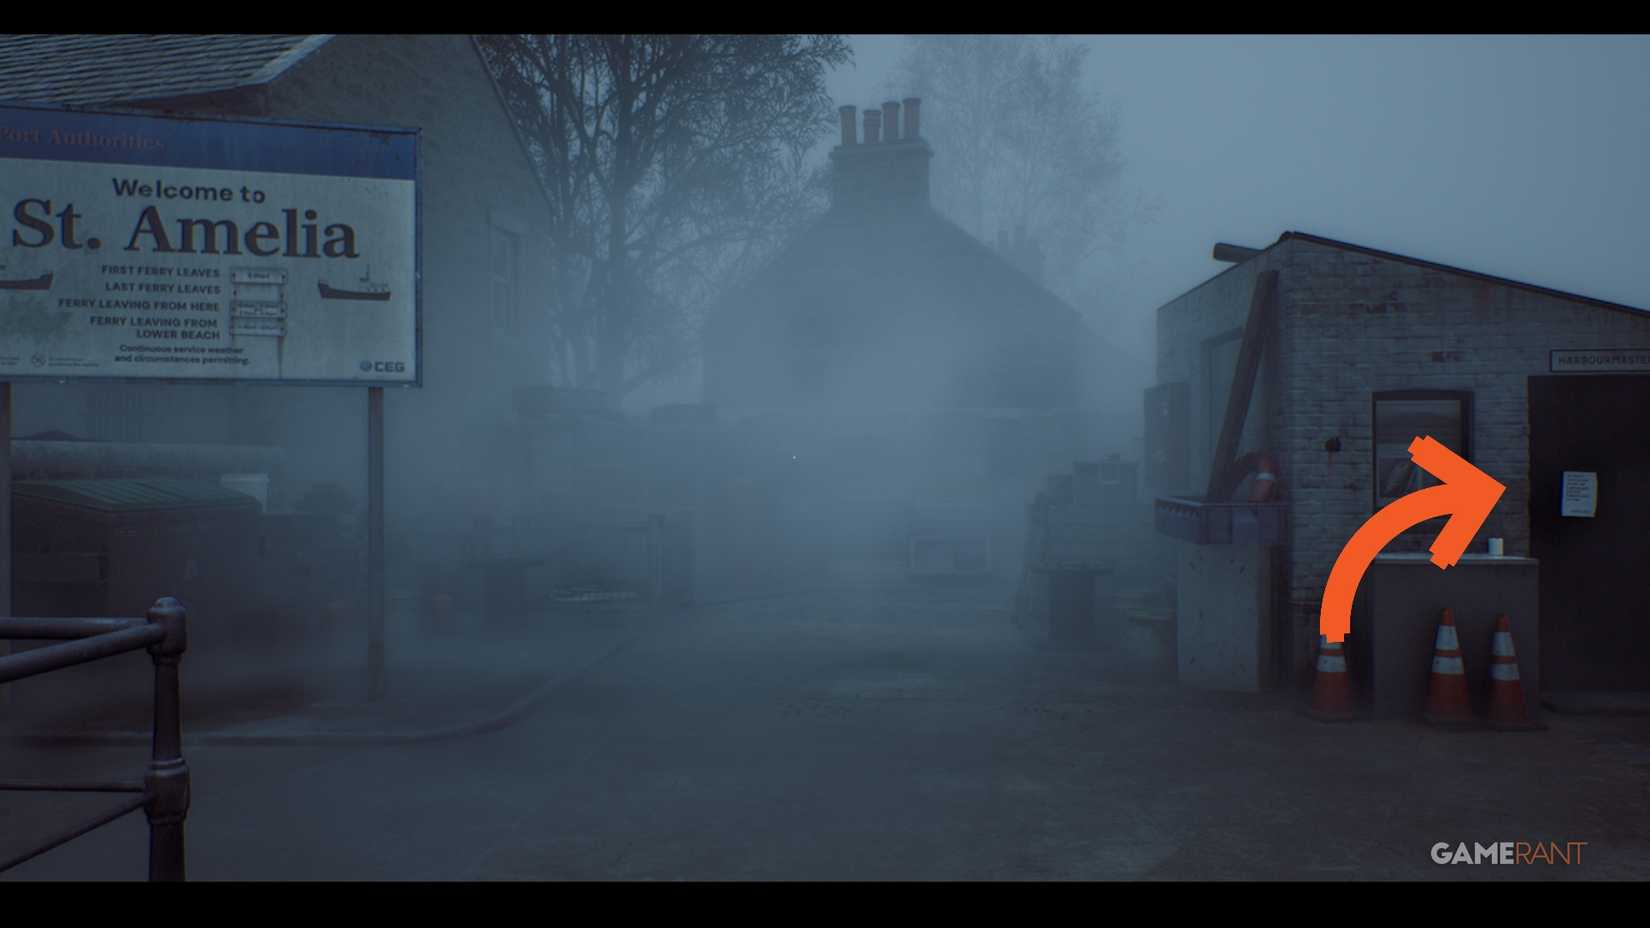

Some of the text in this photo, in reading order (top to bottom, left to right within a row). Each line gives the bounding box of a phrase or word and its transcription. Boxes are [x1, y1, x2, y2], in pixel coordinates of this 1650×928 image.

[48, 128, 164, 153] Authorities
[112, 178, 266, 204] Welcome to
[12, 197, 360, 260] St. Amelia
[101, 265, 221, 279] FIRST FERRY LEAVES
[105, 282, 222, 296] LAST FERRY LEAVES
[58, 298, 221, 313] FERRY LEAVING FROM HERE
[90, 316, 218, 329] FERRY LEAVING FROM
[136, 329, 221, 341] LOWER BEACH
[119, 344, 244, 356] Continuous service weather
[114, 353, 132, 364] and
[134, 354, 200, 365] circumstances
[374, 361, 405, 373] CEG
